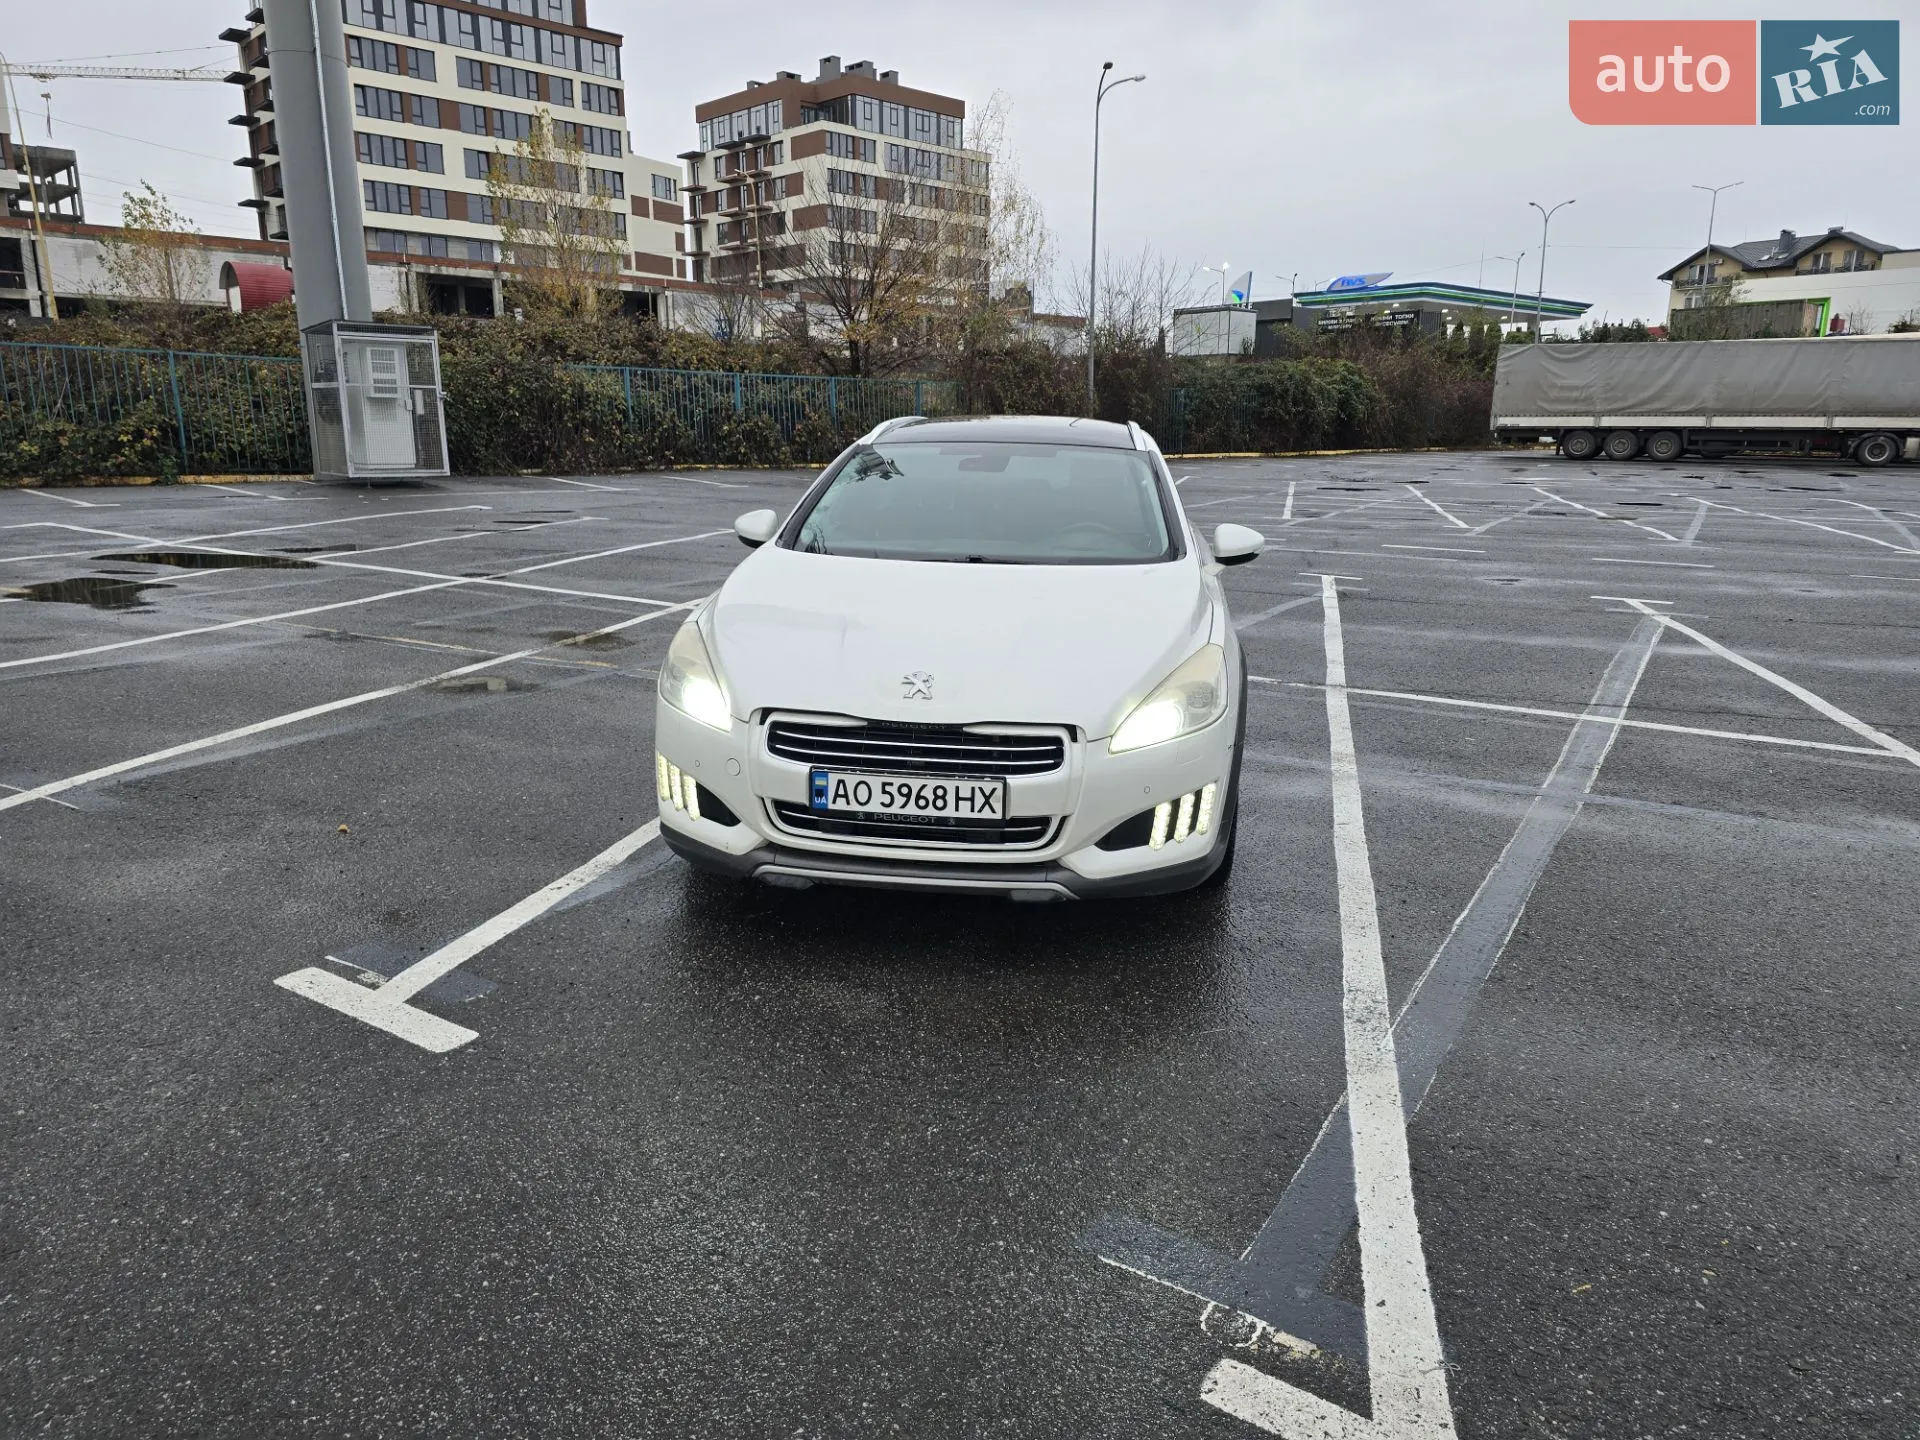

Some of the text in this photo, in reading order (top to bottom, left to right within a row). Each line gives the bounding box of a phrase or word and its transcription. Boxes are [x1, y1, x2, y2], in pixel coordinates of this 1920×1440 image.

[814, 796, 827, 804] UA
[879, 781, 948, 812] 5968
[954, 785, 998, 814] HX
[873, 812, 937, 824] PEUGEOT
